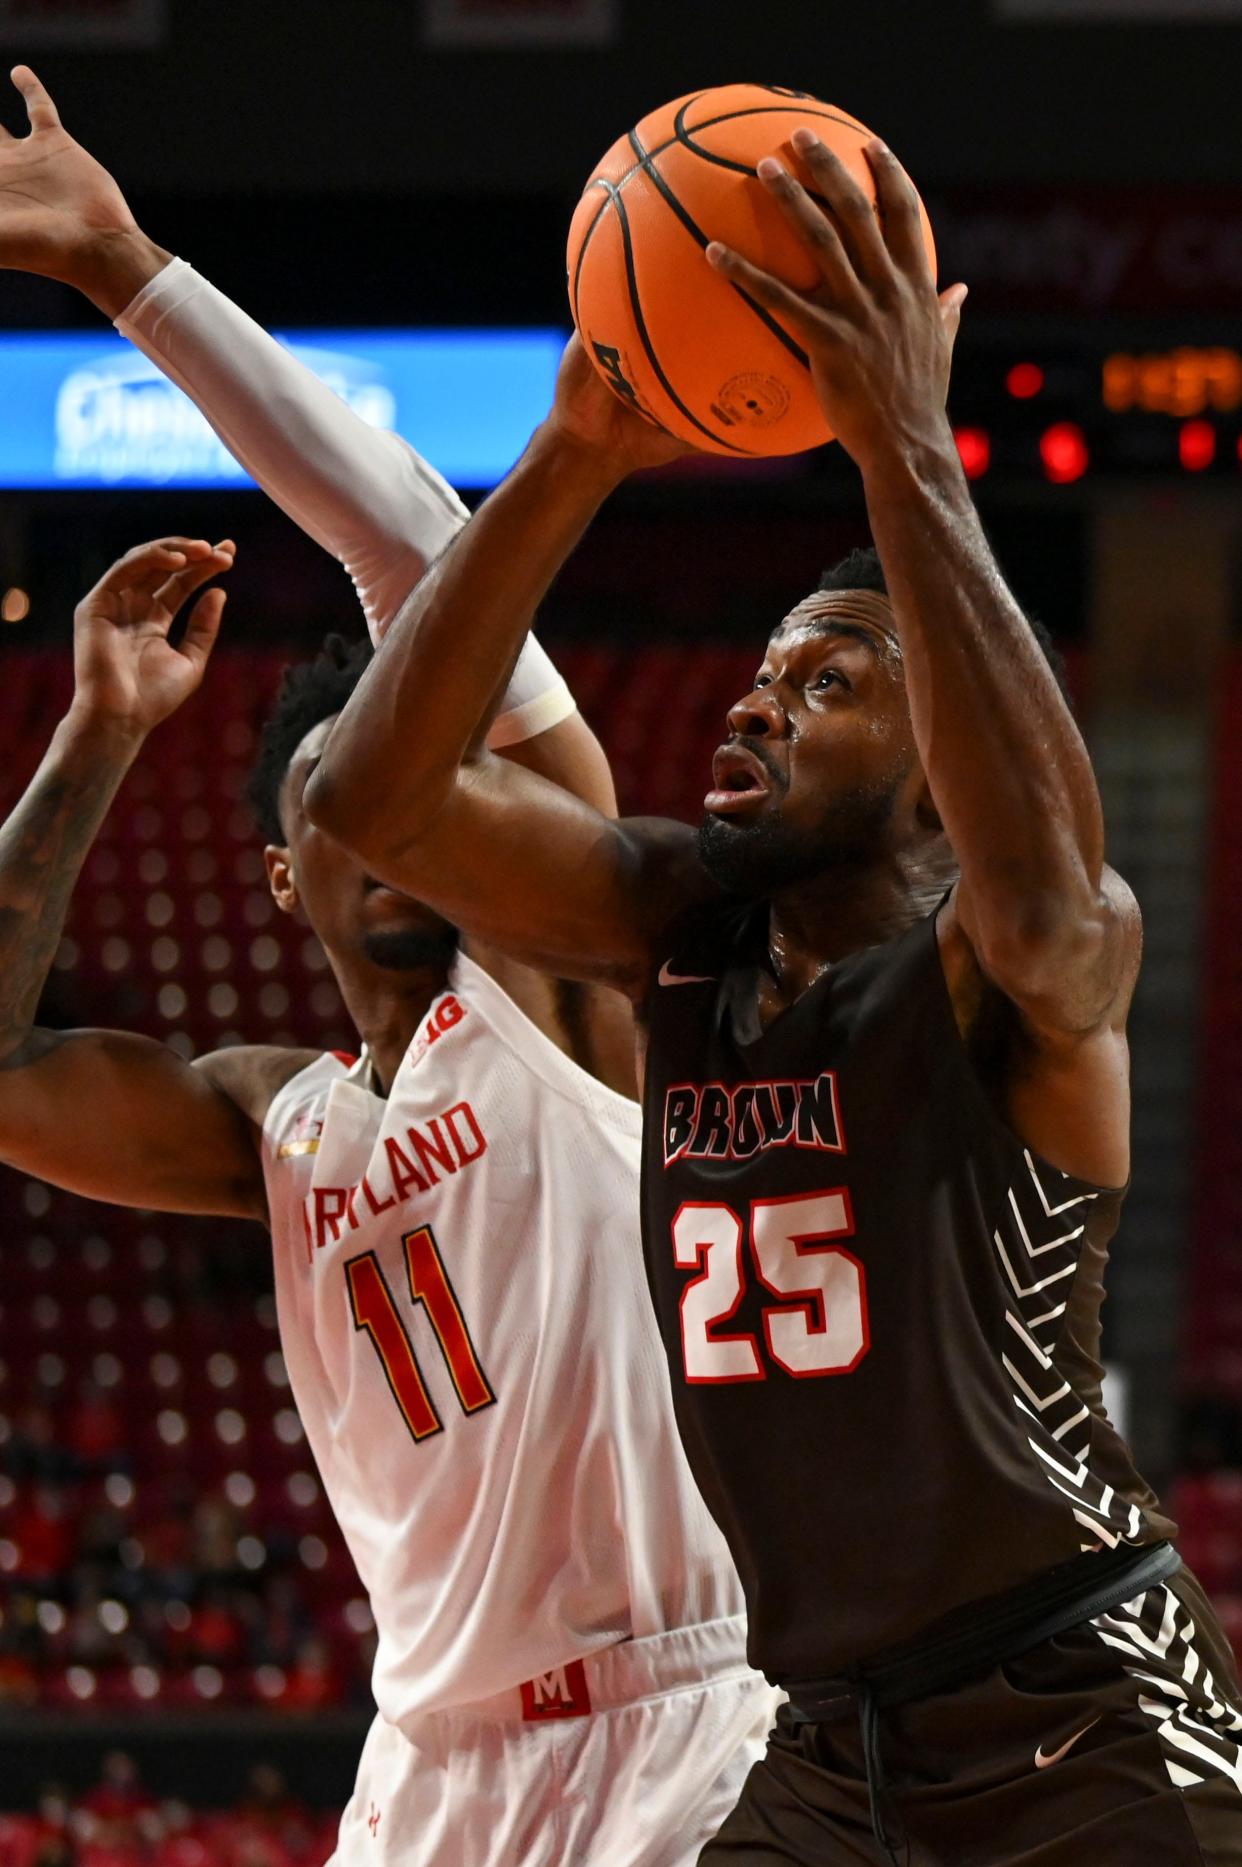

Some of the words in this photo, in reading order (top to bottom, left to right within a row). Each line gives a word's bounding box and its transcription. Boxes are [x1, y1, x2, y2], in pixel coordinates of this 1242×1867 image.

[664, 1072, 847, 1169] BROWN
[344, 1224, 497, 1443] 11
[671, 1186, 871, 1384] 25
[533, 1668, 573, 1705] M
